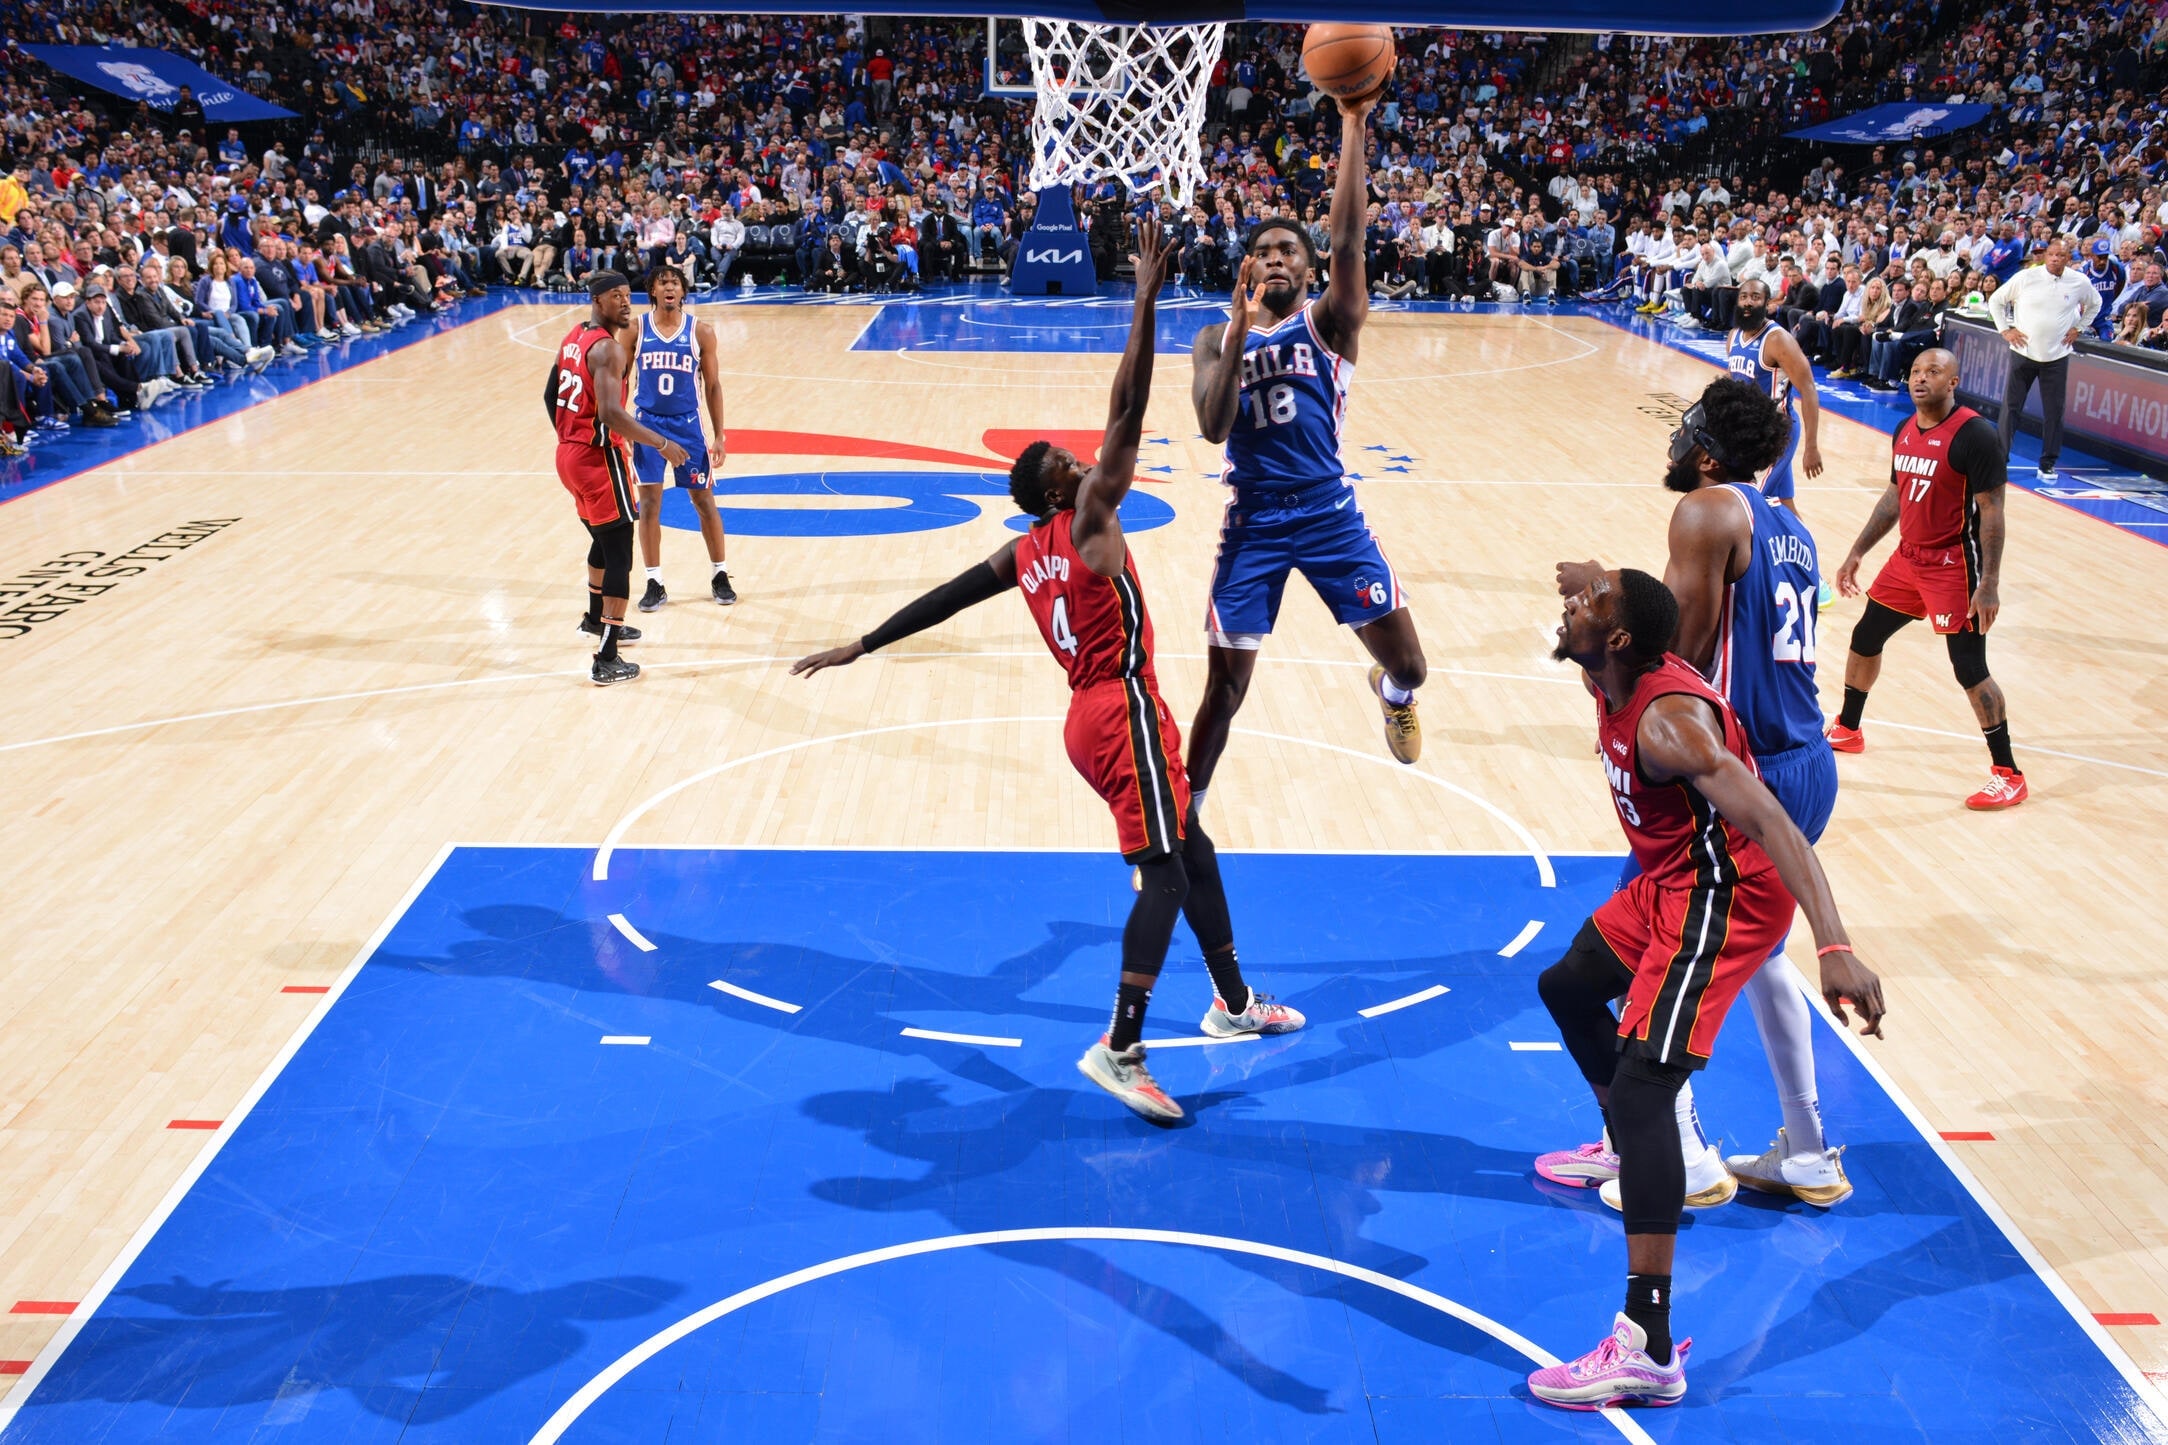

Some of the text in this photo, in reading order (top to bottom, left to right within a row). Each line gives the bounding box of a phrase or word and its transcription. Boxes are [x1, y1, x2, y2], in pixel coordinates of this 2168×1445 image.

[1036, 223, 1073, 232] Google Pixel
[1026, 248, 1083, 264] KIA
[2093, 280, 2115, 291] HILA
[641, 351, 693, 373] PHILA
[1240, 343, 1317, 388] HILA
[556, 369, 583, 413] 22
[658, 373, 674, 396] 0
[1250, 383, 1297, 429] 18
[2071, 380, 2168, 440] PLAY NO
[690, 472, 706, 484] 76
[1908, 478, 1931, 502] 17
[0, 517, 243, 640] WELLS FAR
[0, 551, 106, 606] CENTE
[1355, 581, 1387, 608] 76
[1052, 595, 1078, 656] 4
[1772, 582, 1817, 664] 21
[1612, 738, 1628, 756] UKG
